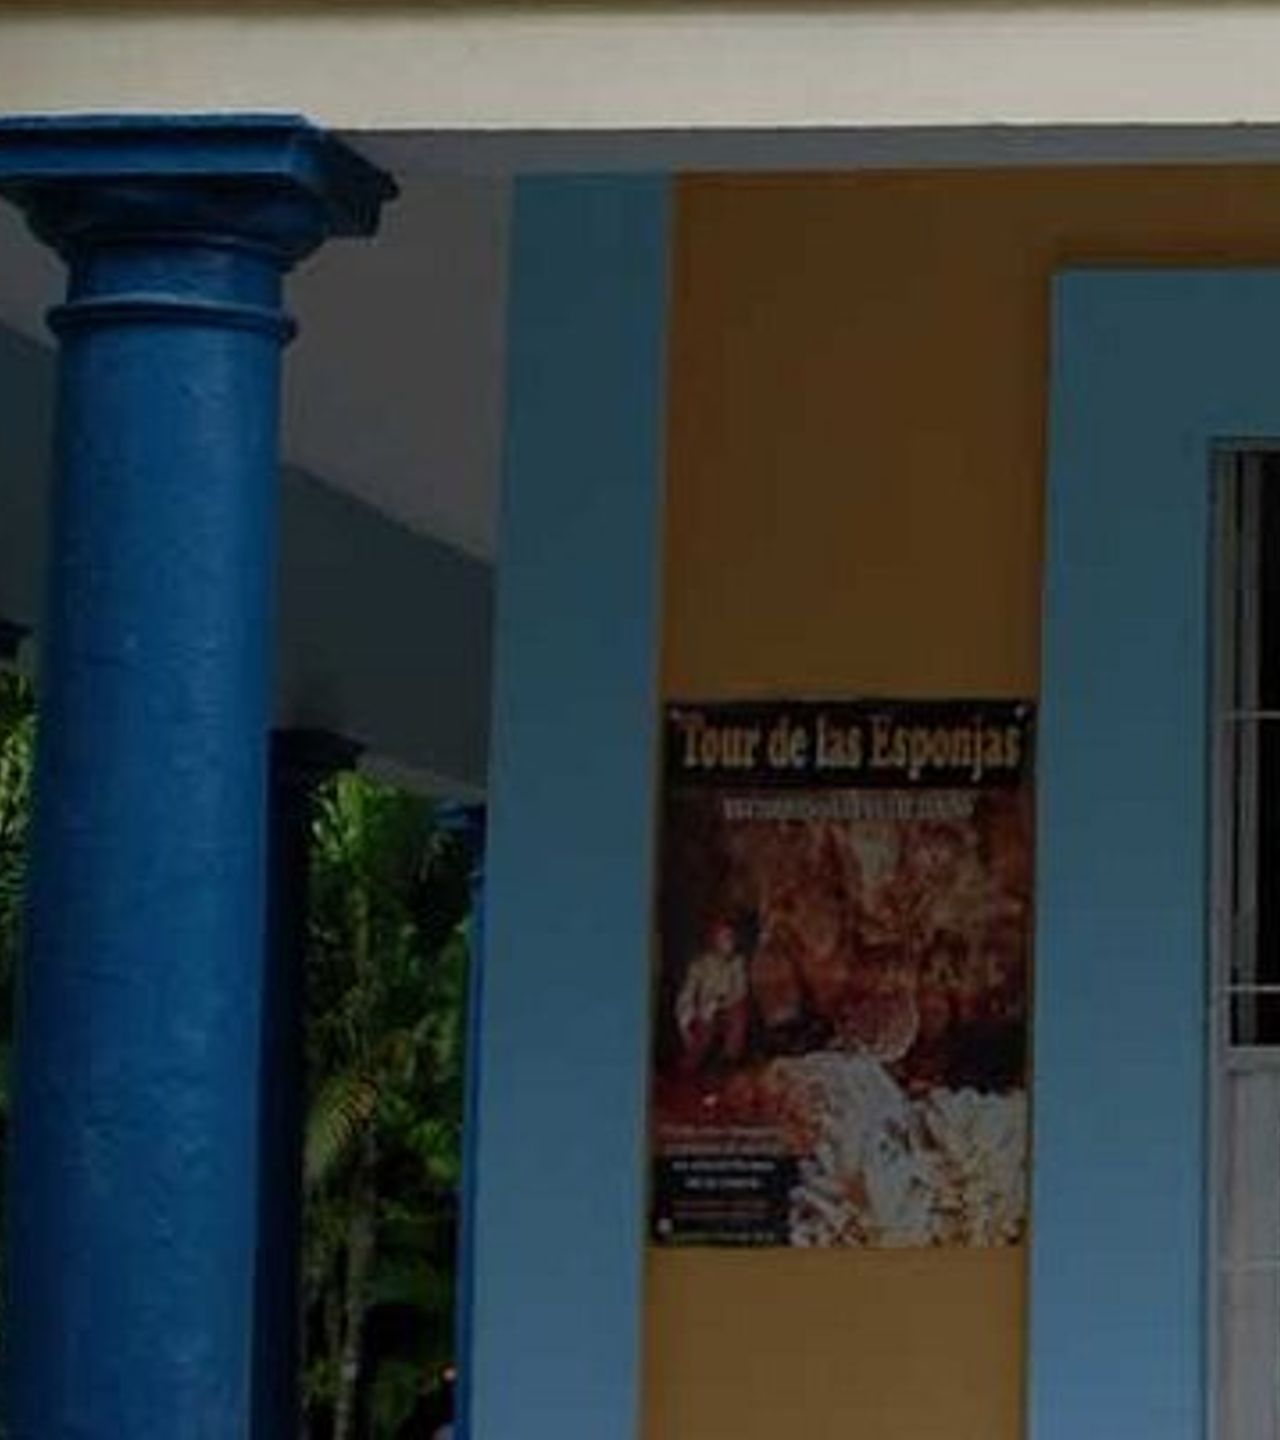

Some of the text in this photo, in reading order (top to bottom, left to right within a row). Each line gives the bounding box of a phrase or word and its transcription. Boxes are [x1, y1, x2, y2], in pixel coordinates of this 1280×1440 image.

[681, 711, 1021, 783] Tour de las Esponjas
